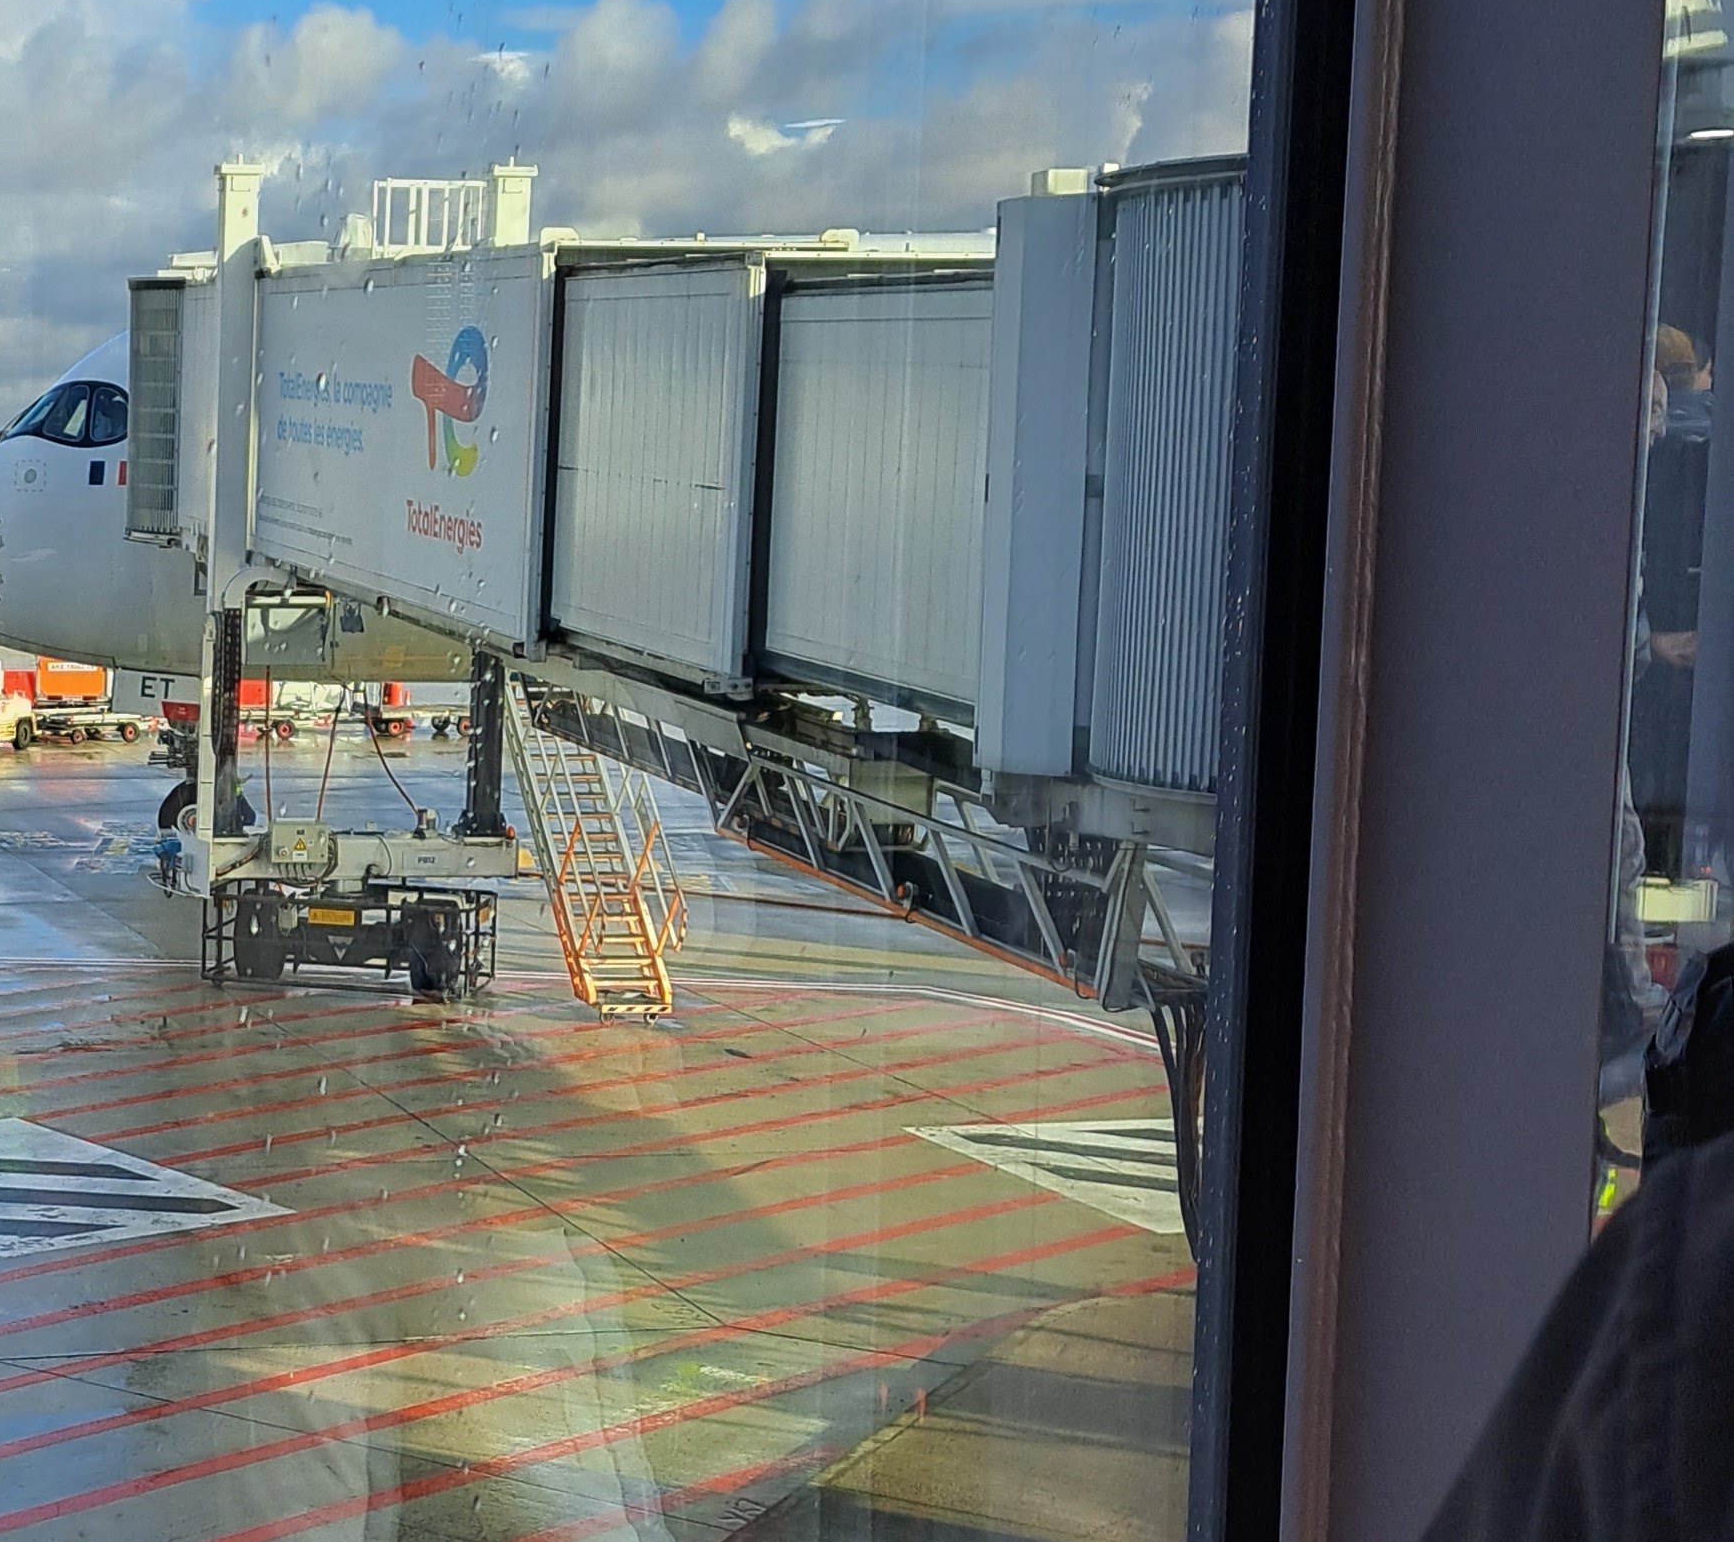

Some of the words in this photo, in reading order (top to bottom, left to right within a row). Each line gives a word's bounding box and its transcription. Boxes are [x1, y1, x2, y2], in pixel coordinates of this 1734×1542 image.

[279, 372, 330, 407] TotalEnergies,
[333, 379, 342, 399] la
[342, 382, 393, 413] compagnie
[277, 415, 288, 441] de
[289, 419, 313, 445] toutes
[313, 419, 325, 446] les
[406, 499, 483, 555] TotalEnergies
[141, 676, 175, 698] ET
